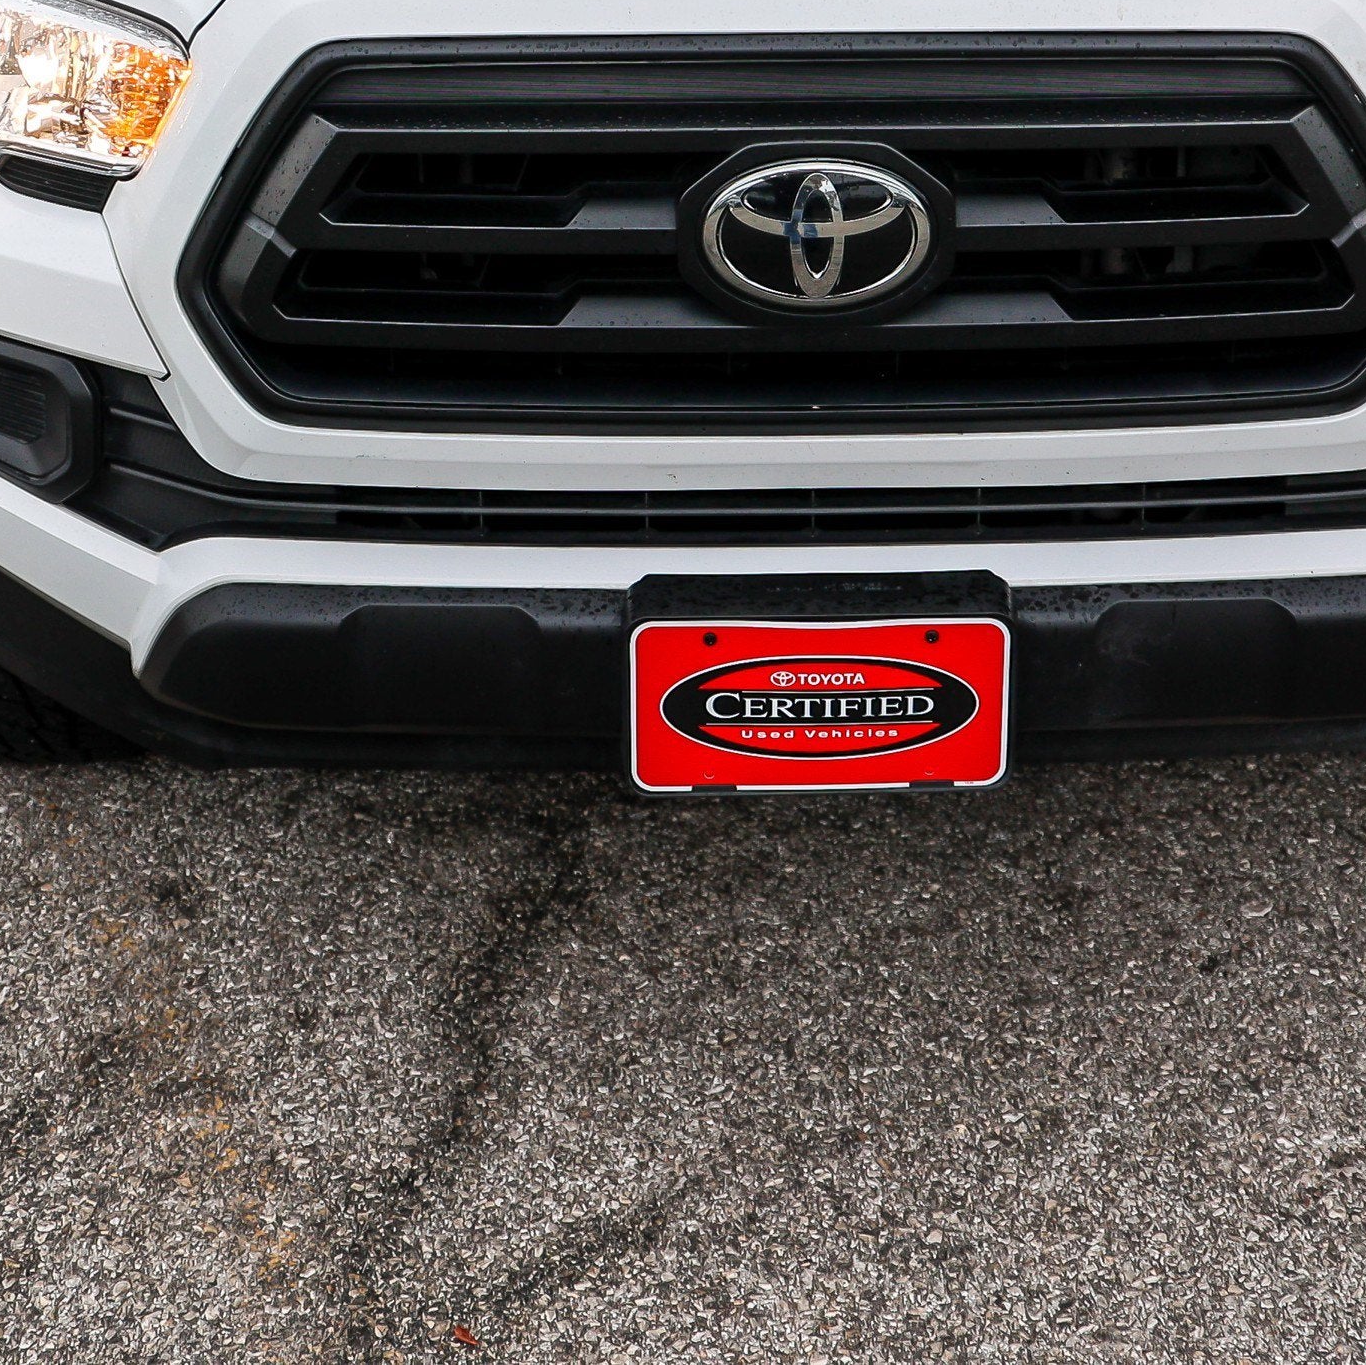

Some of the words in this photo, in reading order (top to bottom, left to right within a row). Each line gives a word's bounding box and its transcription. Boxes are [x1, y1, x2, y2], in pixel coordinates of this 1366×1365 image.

[798, 672, 865, 686] TOYOTA
[705, 692, 934, 719] CERTIFIED
[741, 730, 794, 739] Used
[805, 728, 898, 739] Vehicles
